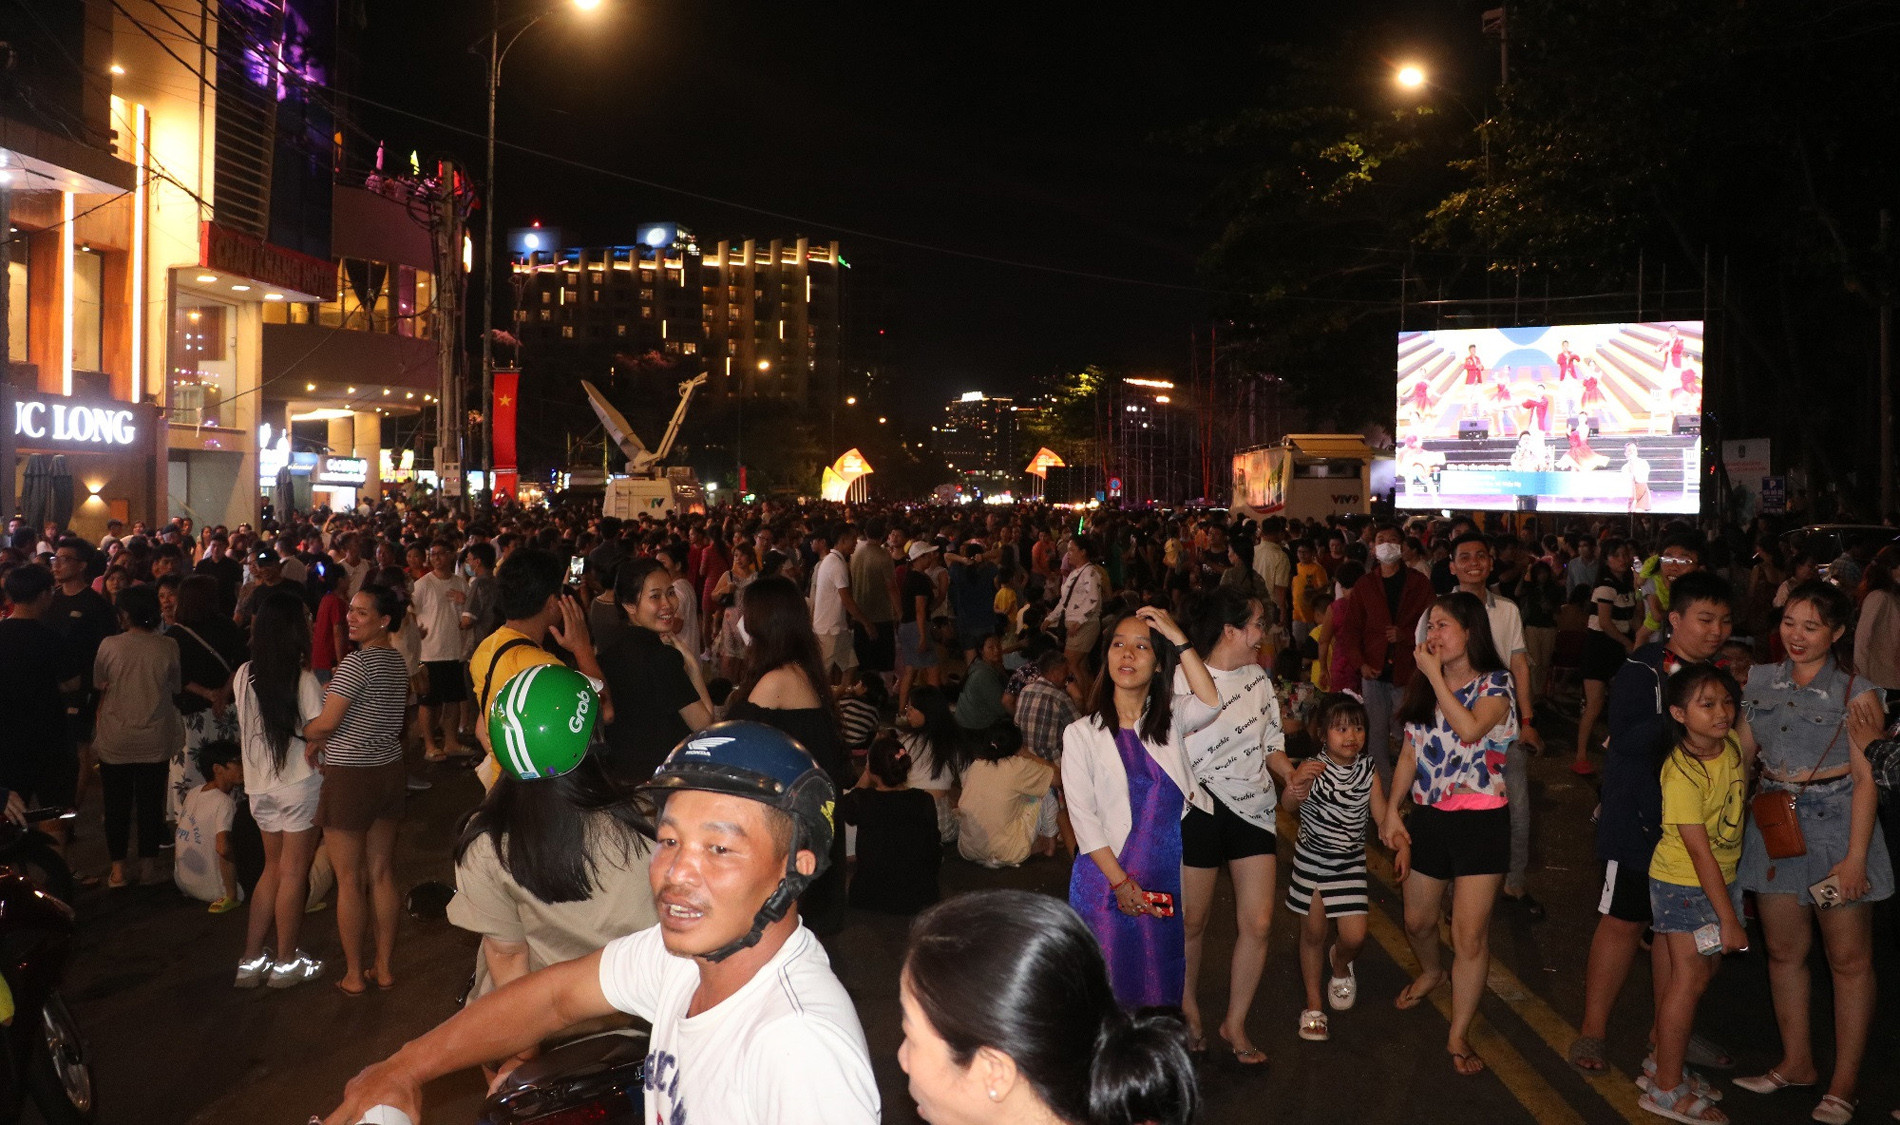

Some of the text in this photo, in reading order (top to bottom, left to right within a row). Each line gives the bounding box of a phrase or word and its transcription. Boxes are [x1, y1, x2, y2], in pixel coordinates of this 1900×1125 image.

[52, 404, 136, 444] LONG
[641, 497, 666, 508] VTV
[1331, 494, 1359, 505] VTV9
[569, 690, 590, 734] Grab
